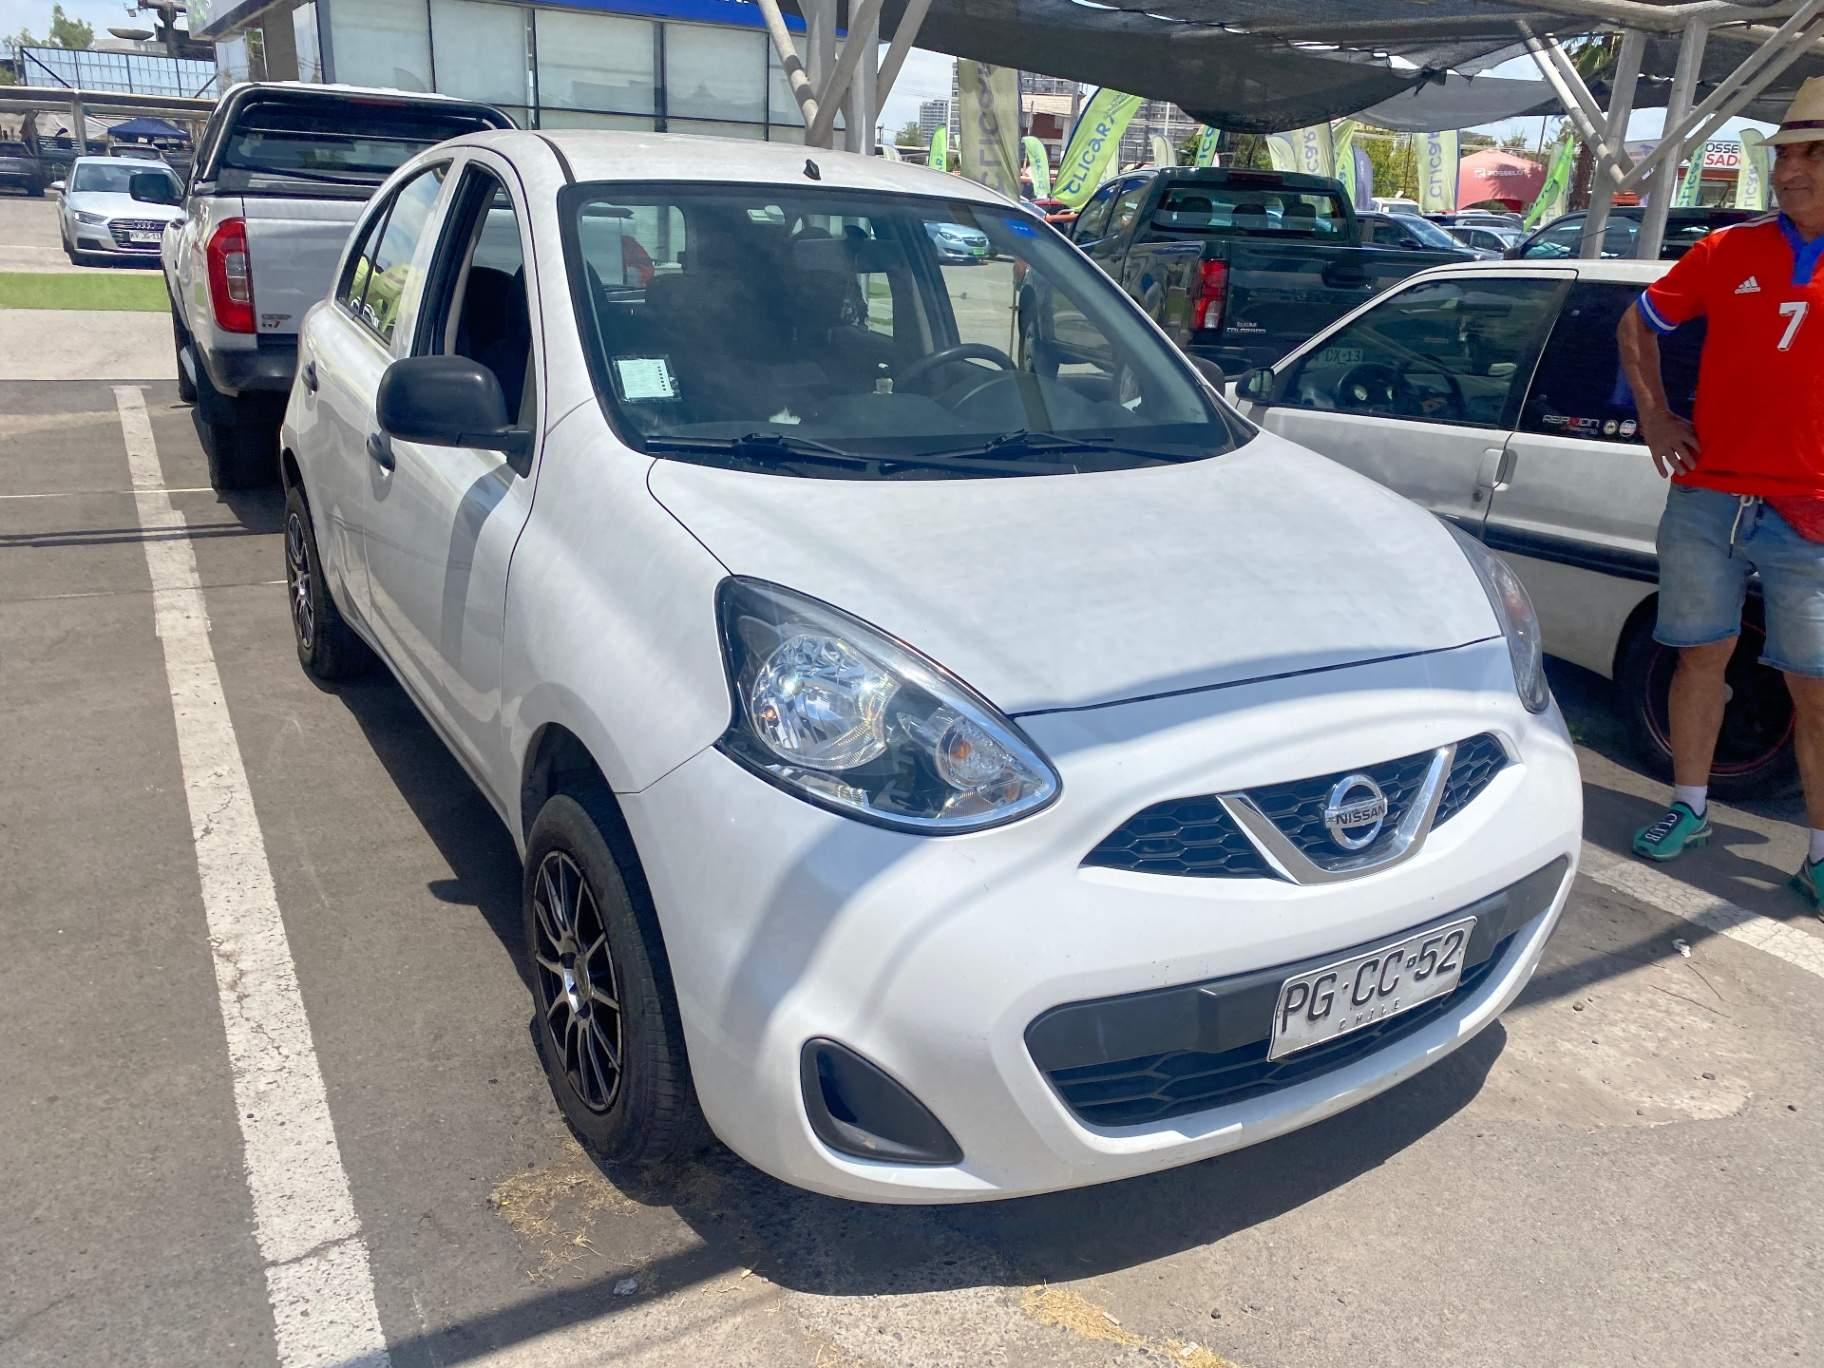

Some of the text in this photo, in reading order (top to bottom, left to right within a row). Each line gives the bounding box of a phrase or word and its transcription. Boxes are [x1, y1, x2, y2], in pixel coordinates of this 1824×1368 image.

[1705, 142, 1741, 154] OSSE
[1705, 154, 1742, 166] SAD
[1776, 301, 1809, 352] 7
[1336, 803, 1385, 825] NISSAN
